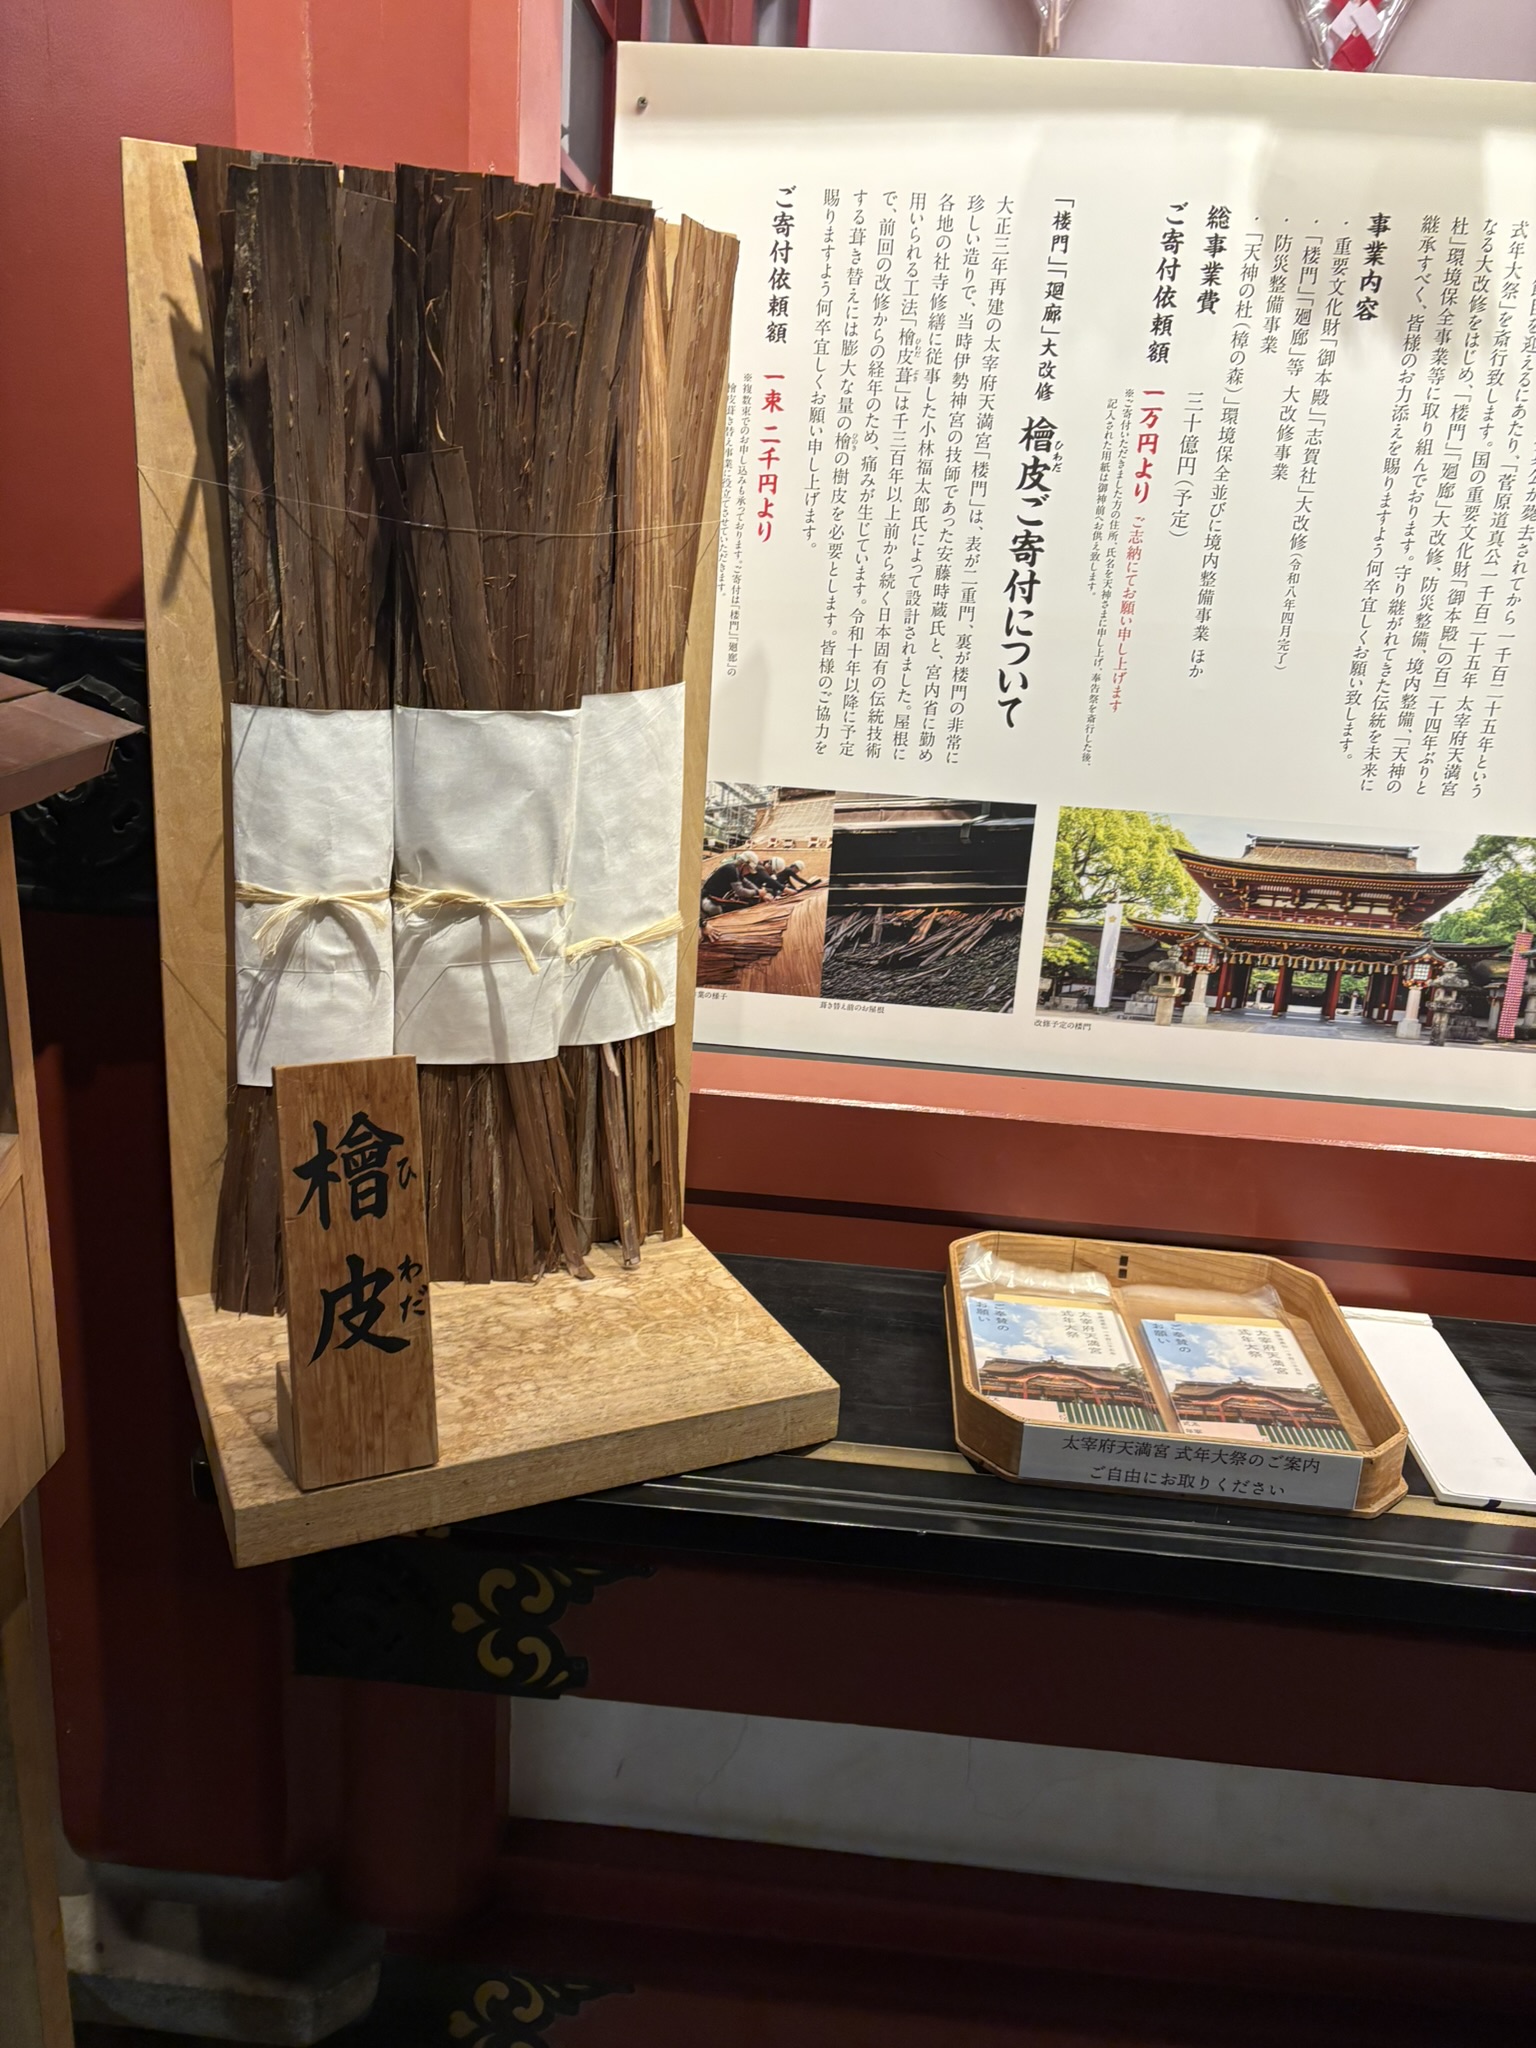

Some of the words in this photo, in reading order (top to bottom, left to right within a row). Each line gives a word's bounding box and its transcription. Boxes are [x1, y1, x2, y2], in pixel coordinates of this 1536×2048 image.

[765, 185, 796, 344] ご寄付依頼額
[1034, 199, 1075, 401] 「楼門」「廻廊」大改修
[1146, 202, 1188, 364] ご寄付依頼額
[1197, 205, 1232, 315] 総事業費
[1353, 212, 1391, 321] 事業内容
[757, 426, 781, 542] 二千円より
[1049, 441, 1064, 472] ひわだ
[1135, 391, 1165, 503] 一万円より
[1169, 392, 1204, 536] 三十億円（予定）
[998, 416, 1059, 728] 檜皮ご寄付について
[1110, 517, 1145, 712] ご志納にてお願い申し上げます
[1034, 1018, 1092, 1031] 改修予定の楼門
[292, 1111, 411, 1366] 檜皮
[1062, 1435, 1171, 1460] 太宰府天満宮
[1175, 1450, 1321, 1474] 式年大祭のご案内
[1091, 1465, 1285, 1496] ご自由にお取りください
